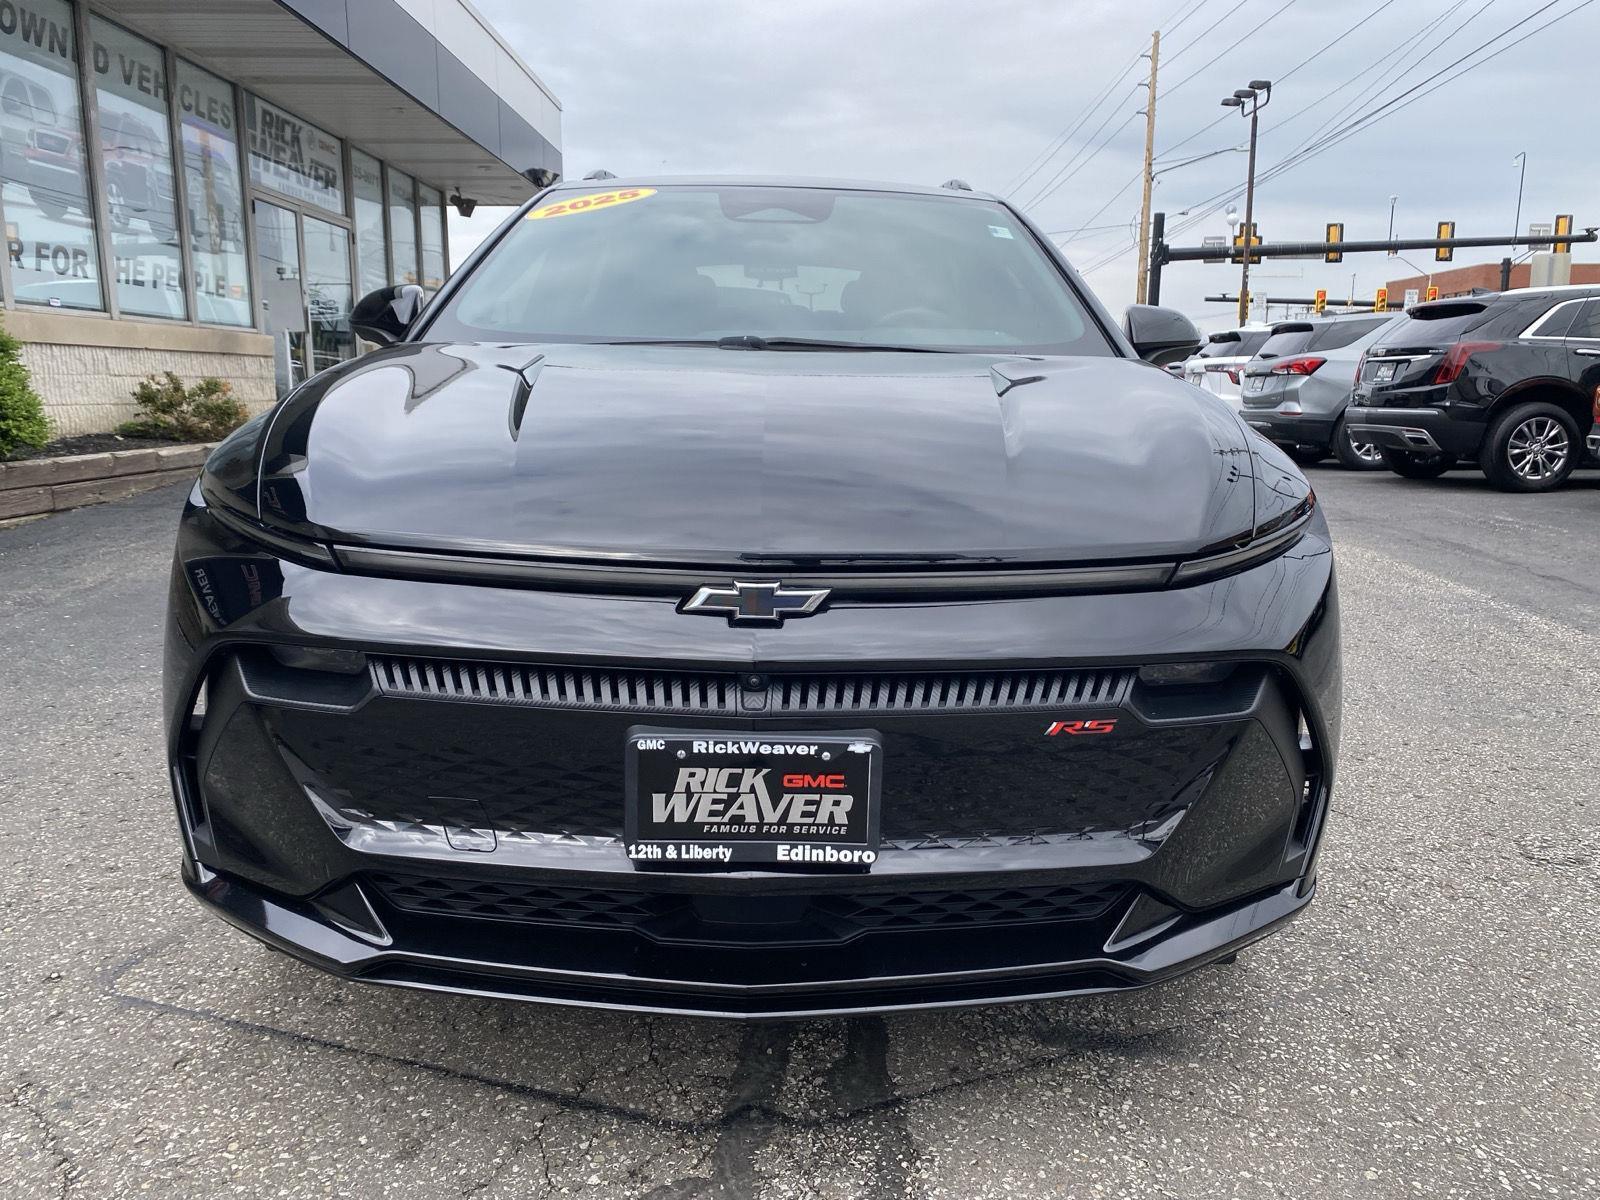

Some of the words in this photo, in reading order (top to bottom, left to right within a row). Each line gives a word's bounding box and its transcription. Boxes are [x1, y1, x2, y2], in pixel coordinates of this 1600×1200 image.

[0, 2, 109, 75] OWND
[118, 54, 231, 130] VEHCLES
[261, 106, 303, 152] RICK
[543, 190, 641, 217] 2025
[35, 241, 88, 279] FOR
[116, 256, 145, 288] HE
[152, 263, 226, 297] PEPLE
[1044, 719, 1118, 736] RS
[637, 740, 666, 750] GMC
[692, 741, 818, 755] RickWeaver
[674, 767, 772, 793] RICK
[783, 774, 847, 788] GMC
[652, 793, 854, 824] WEAVER
[703, 825, 757, 833] FAMOUS
[762, 825, 787, 834] FOR
[793, 826, 848, 835] SERVICE
[628, 844, 662, 859] 12th
[665, 844, 677, 859] &
[681, 844, 732, 862] Liberty
[776, 844, 876, 863] Edinboro
